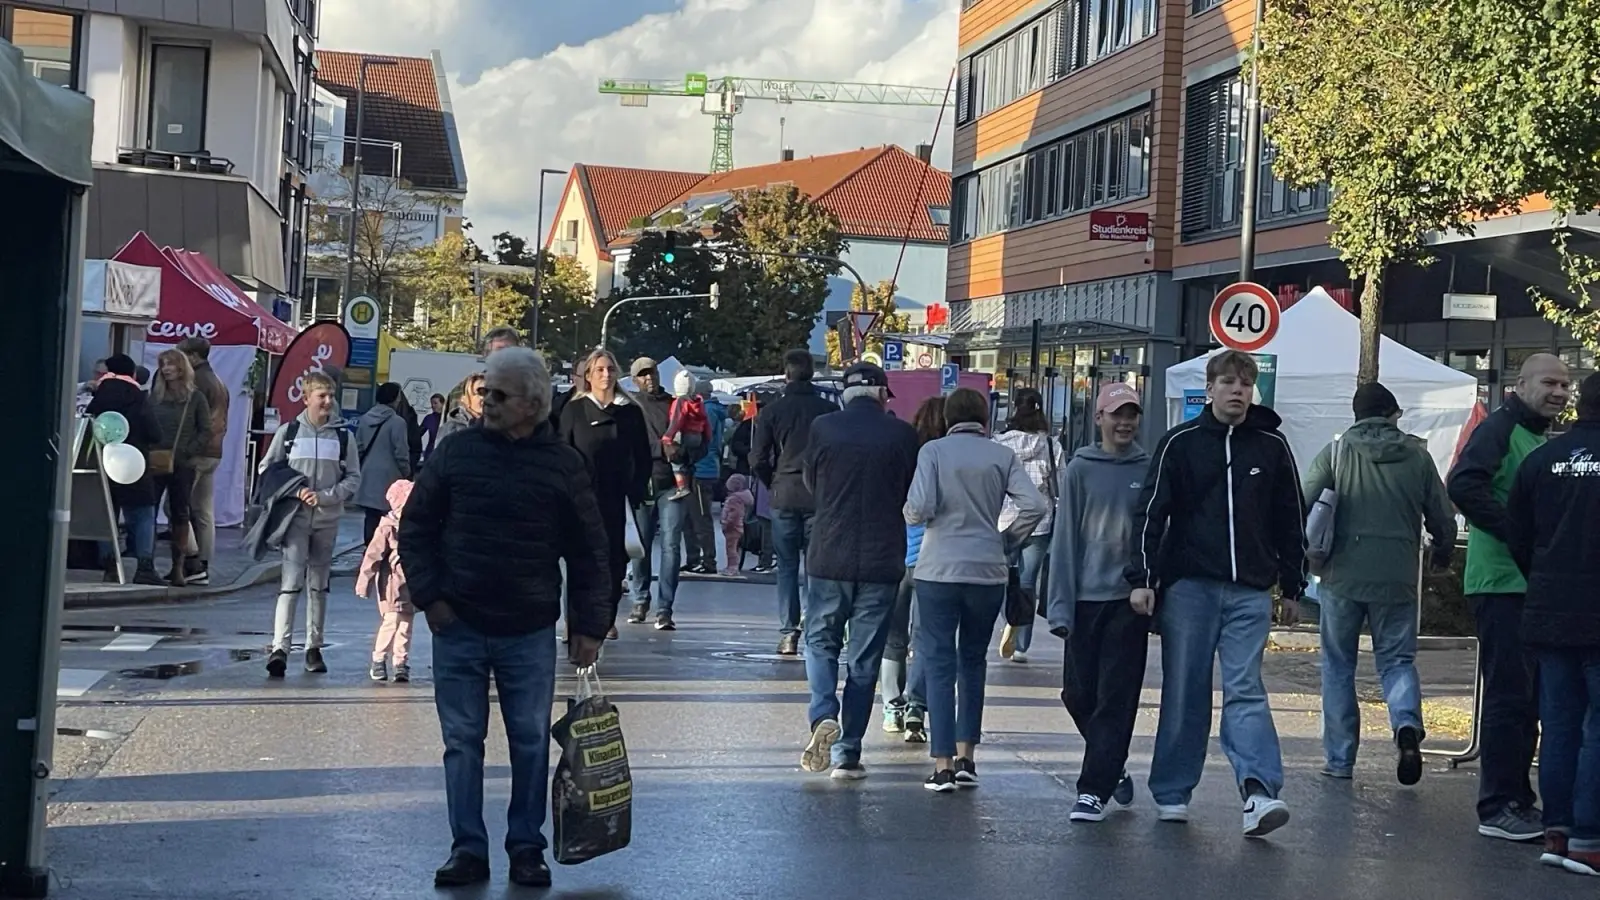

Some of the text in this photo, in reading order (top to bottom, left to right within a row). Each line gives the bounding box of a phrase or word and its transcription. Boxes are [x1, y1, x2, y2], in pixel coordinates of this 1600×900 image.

[1092, 224, 1147, 235] Studienkreis
[1225, 303, 1266, 334] 40
[147, 320, 218, 338] cewe
[886, 344, 898, 360] P
[942, 366, 953, 386] P
